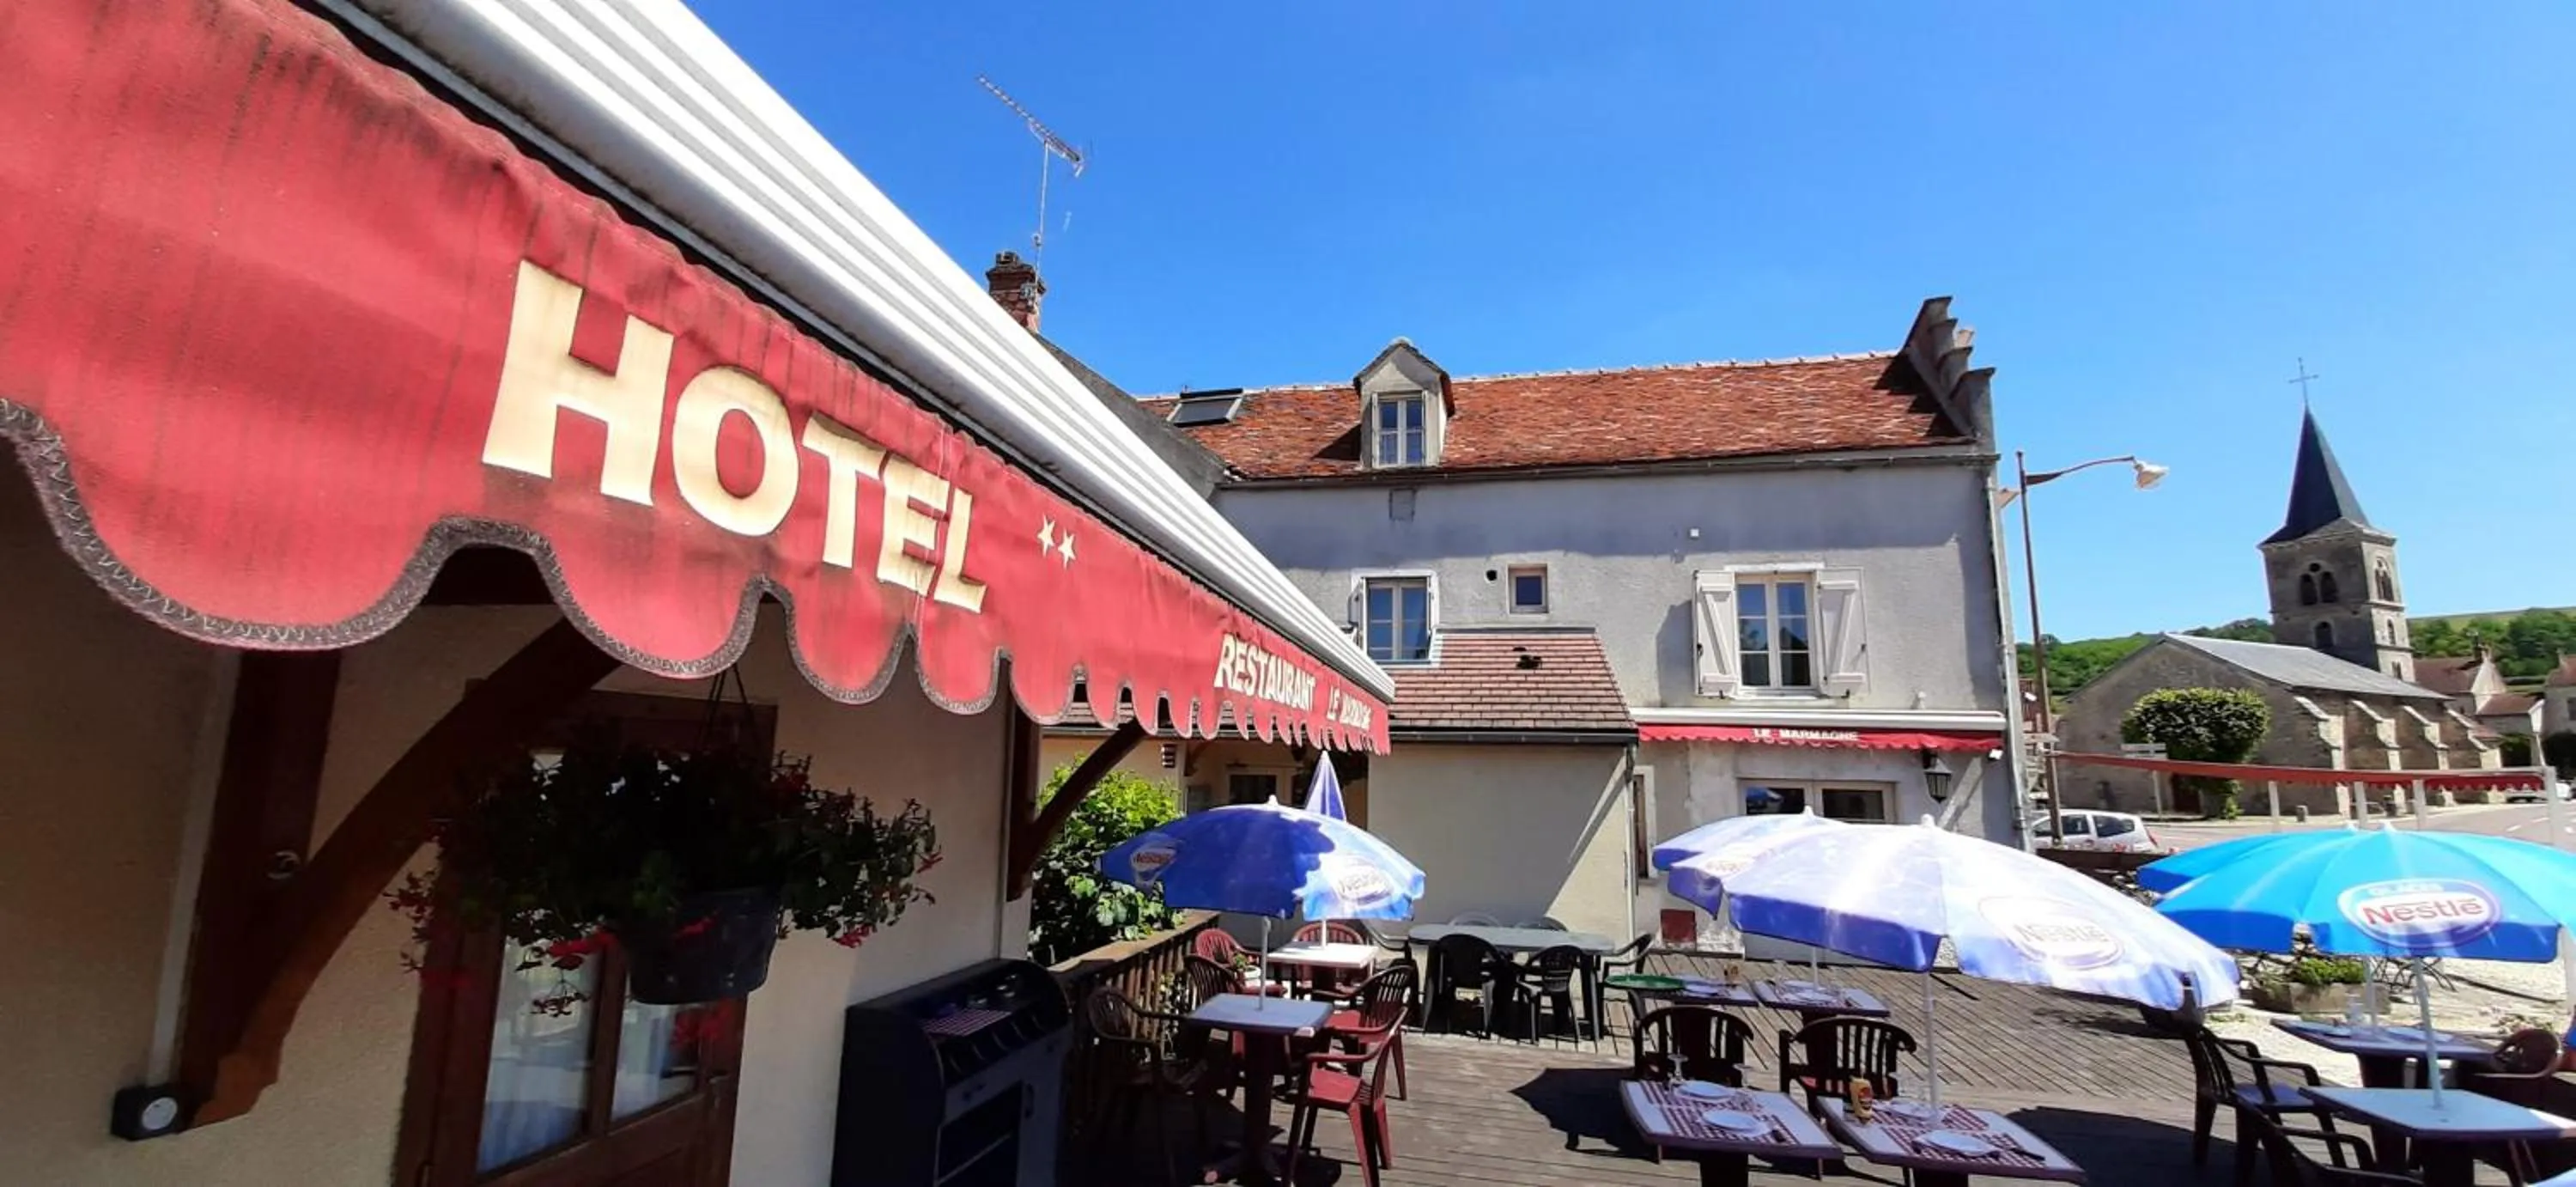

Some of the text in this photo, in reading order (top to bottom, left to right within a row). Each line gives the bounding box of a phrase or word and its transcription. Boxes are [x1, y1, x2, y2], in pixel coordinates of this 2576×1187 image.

[481, 259, 988, 614] HOTEL
[1214, 632, 1316, 713] RESTAURANT
[1327, 685, 1340, 721] LE
[1753, 727, 1771, 738] LE
